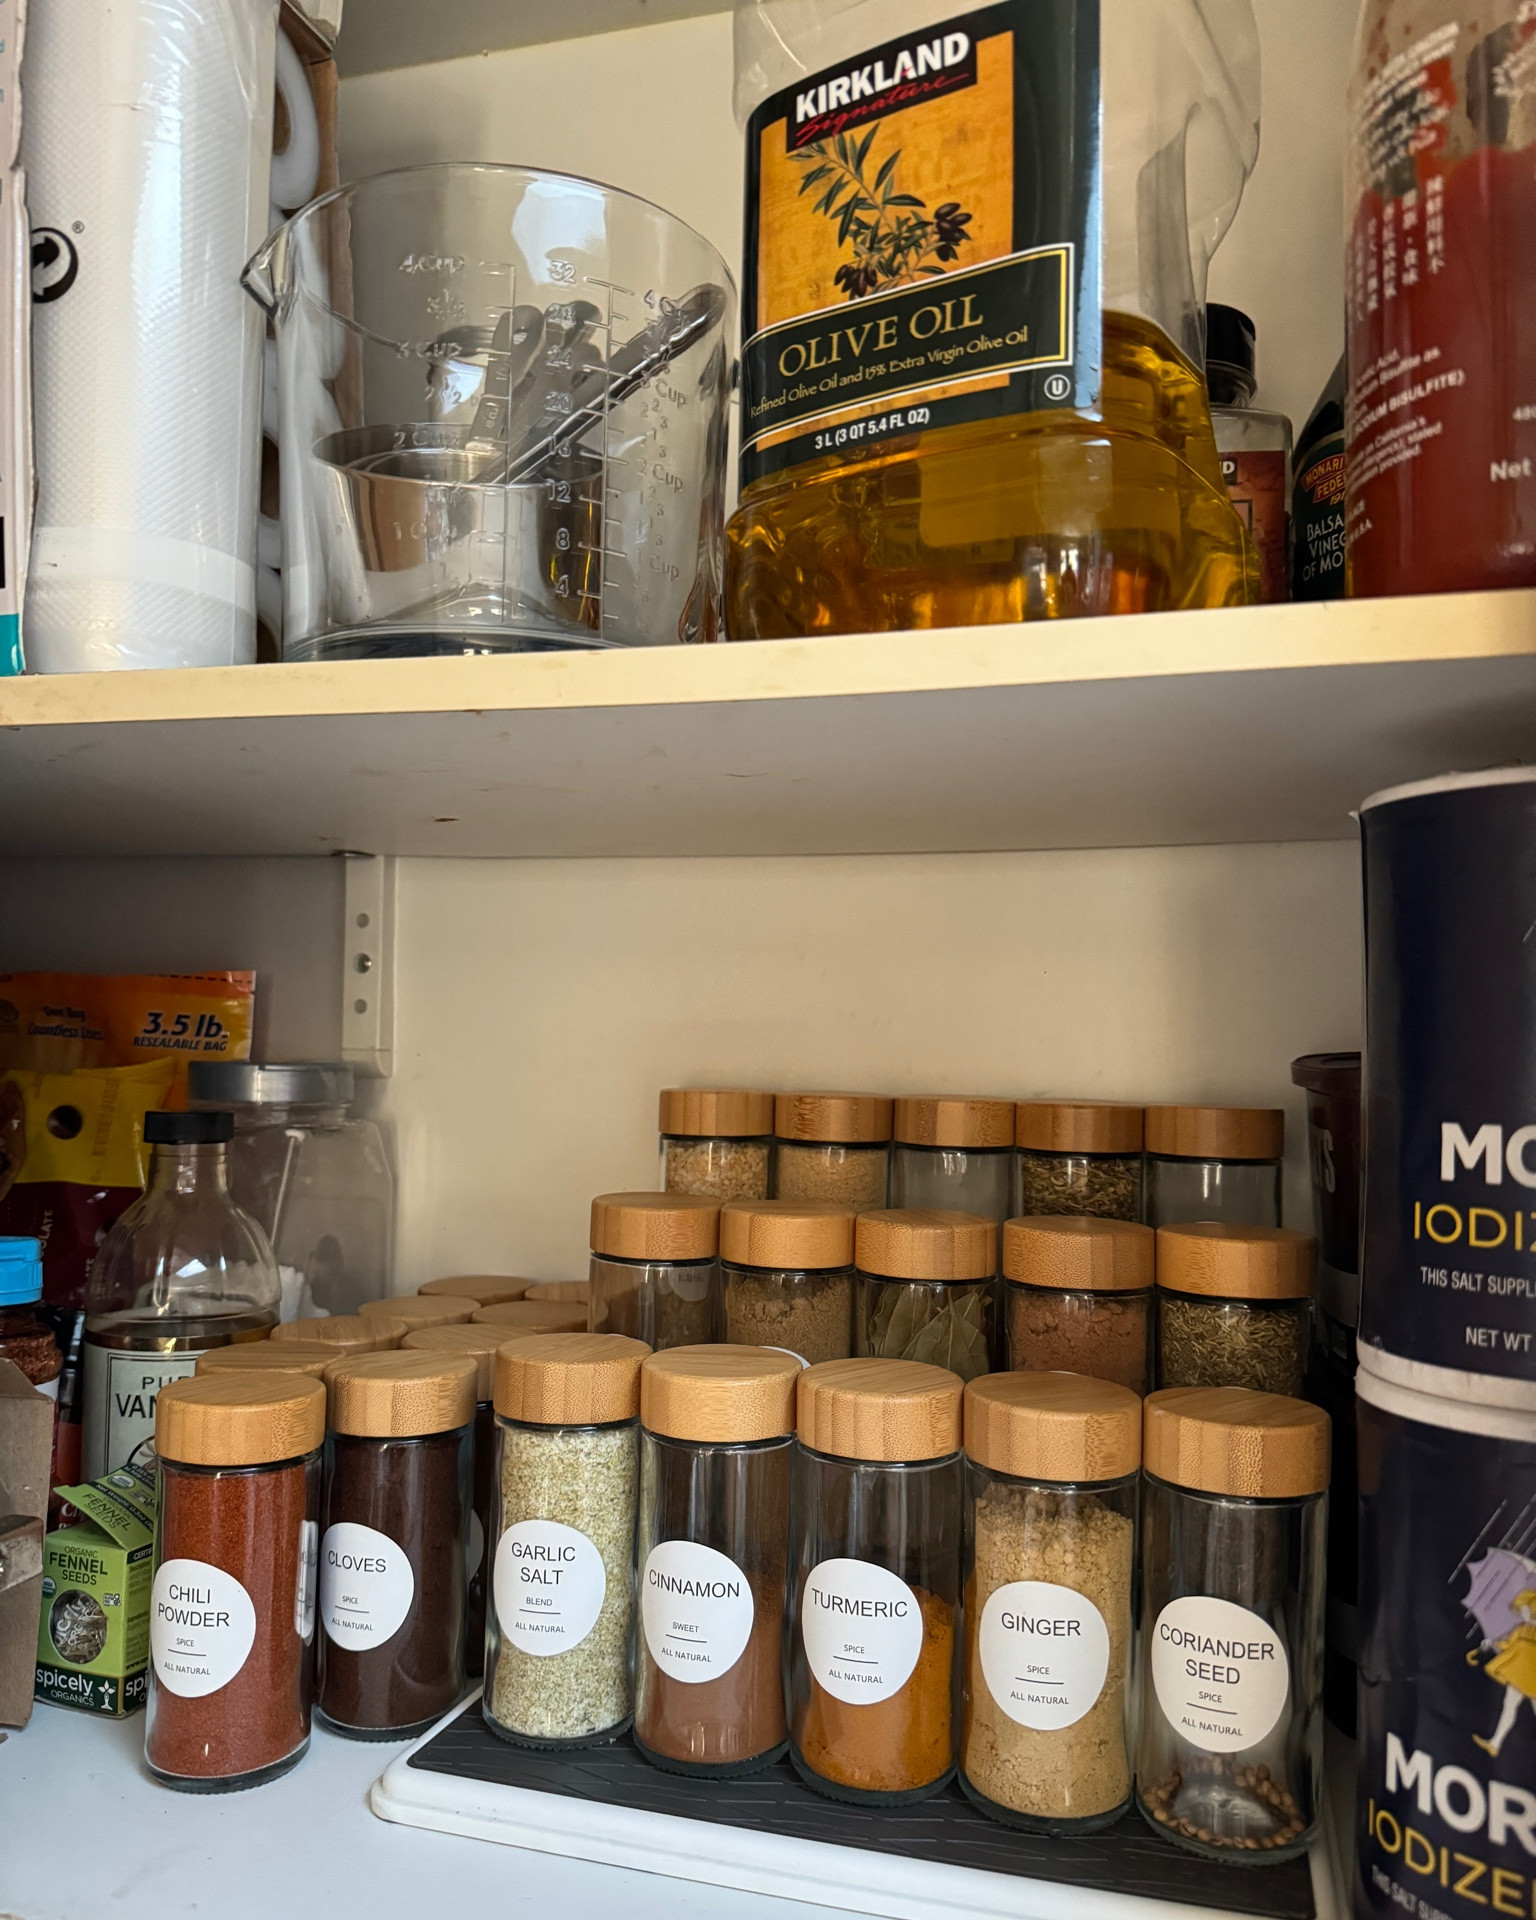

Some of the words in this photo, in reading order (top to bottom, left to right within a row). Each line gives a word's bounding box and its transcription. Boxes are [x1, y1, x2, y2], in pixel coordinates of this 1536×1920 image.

[796, 32, 969, 123] KIRKLAND
[796, 73, 969, 146] Signature
[551, 260, 578, 284] 32
[779, 316, 898, 377] OLIVE
[909, 294, 983, 341] OIL
[751, 392, 786, 418] Refined
[788, 383, 817, 401] Olive
[819, 373, 837, 391] Oil
[838, 367, 863, 386] and
[865, 364, 887, 381] 15%
[889, 355, 925, 374] Extra
[927, 345, 965, 366] Virgin
[967, 334, 1003, 353] Olive
[1005, 326, 1028, 345] Oil
[655, 378, 687, 410] Cup
[815, 435, 824, 449] 3
[825, 434, 832, 447] L
[835, 429, 848, 446] (3
[849, 423, 866, 441] QT
[868, 419, 887, 436] 5.4
[889, 415, 905, 431] FL
[908, 408, 930, 427] OZ)
[652, 463, 684, 493] Cup
[1220, 460, 1235, 474] D
[1306, 458, 1344, 486] MONARI
[549, 483, 572, 503] 12
[555, 528, 571, 550] 8
[1307, 513, 1344, 541] BALSA
[1303, 561, 1316, 582] OF
[1319, 552, 1344, 574] MO
[555, 574, 570, 598] 4
[143, 1012, 191, 1036] 3.5
[194, 1014, 229, 1038] lb.
[134, 1037, 200, 1050] RESEALABLE
[203, 1041, 227, 1051] BAG
[38, 1209, 54, 1257] OLATE
[1414, 1201, 1536, 1253] IODI
[1420, 1265, 1448, 1288] THIS
[1451, 1271, 1484, 1292] SALT
[1488, 1275, 1536, 1299] SUPPL
[1465, 1326, 1499, 1348] NET
[1503, 1333, 1533, 1353] WT
[83, 1493, 131, 1531] FENNEL
[84, 1503, 117, 1529] SEEDS
[50, 1552, 108, 1575] FENNEL
[64, 1546, 98, 1559] ORGANIC
[328, 1550, 387, 1573] CLOVES
[511, 1541, 576, 1562] GARLIC
[62, 1570, 97, 1585] SEEDS
[520, 1567, 564, 1585] SALT
[649, 1569, 740, 1598] CINNAMON
[169, 1584, 211, 1604] CHILI
[342, 1595, 359, 1605] SPICE
[526, 1597, 553, 1606] BLEND
[812, 1588, 908, 1619] TURMERIC
[158, 1603, 230, 1628] POWDER
[331, 1617, 342, 1627] ALL
[342, 1619, 374, 1631] NATURAL
[515, 1621, 527, 1631] ALL
[528, 1623, 566, 1634] NATURAL
[672, 1621, 700, 1633] SWEET
[1001, 1612, 1082, 1637] GINGER
[176, 1637, 195, 1648] SPICE
[843, 1643, 865, 1654] SPICE
[1160, 1623, 1275, 1660] CORIANDER
[661, 1647, 674, 1658] ALL
[674, 1650, 712, 1663] NATURAL
[164, 1662, 175, 1672] ALL
[175, 1663, 211, 1676] NATURAL
[829, 1668, 842, 1680] ALL
[844, 1672, 884, 1684] NATURAL
[1026, 1664, 1050, 1675] SPICE
[1186, 1659, 1240, 1685] SEED
[36, 1669, 93, 1696] spicely
[51, 1689, 95, 1706] ORGANICS
[1010, 1691, 1025, 1702] ALL
[1027, 1693, 1069, 1705] NATURAL
[1198, 1691, 1223, 1703] SPICE
[1181, 1716, 1196, 1728] ALL
[1199, 1721, 1243, 1736] NATURAL
[1385, 1731, 1536, 1857] MOR
[1368, 1798, 1536, 1920] IODIZE
